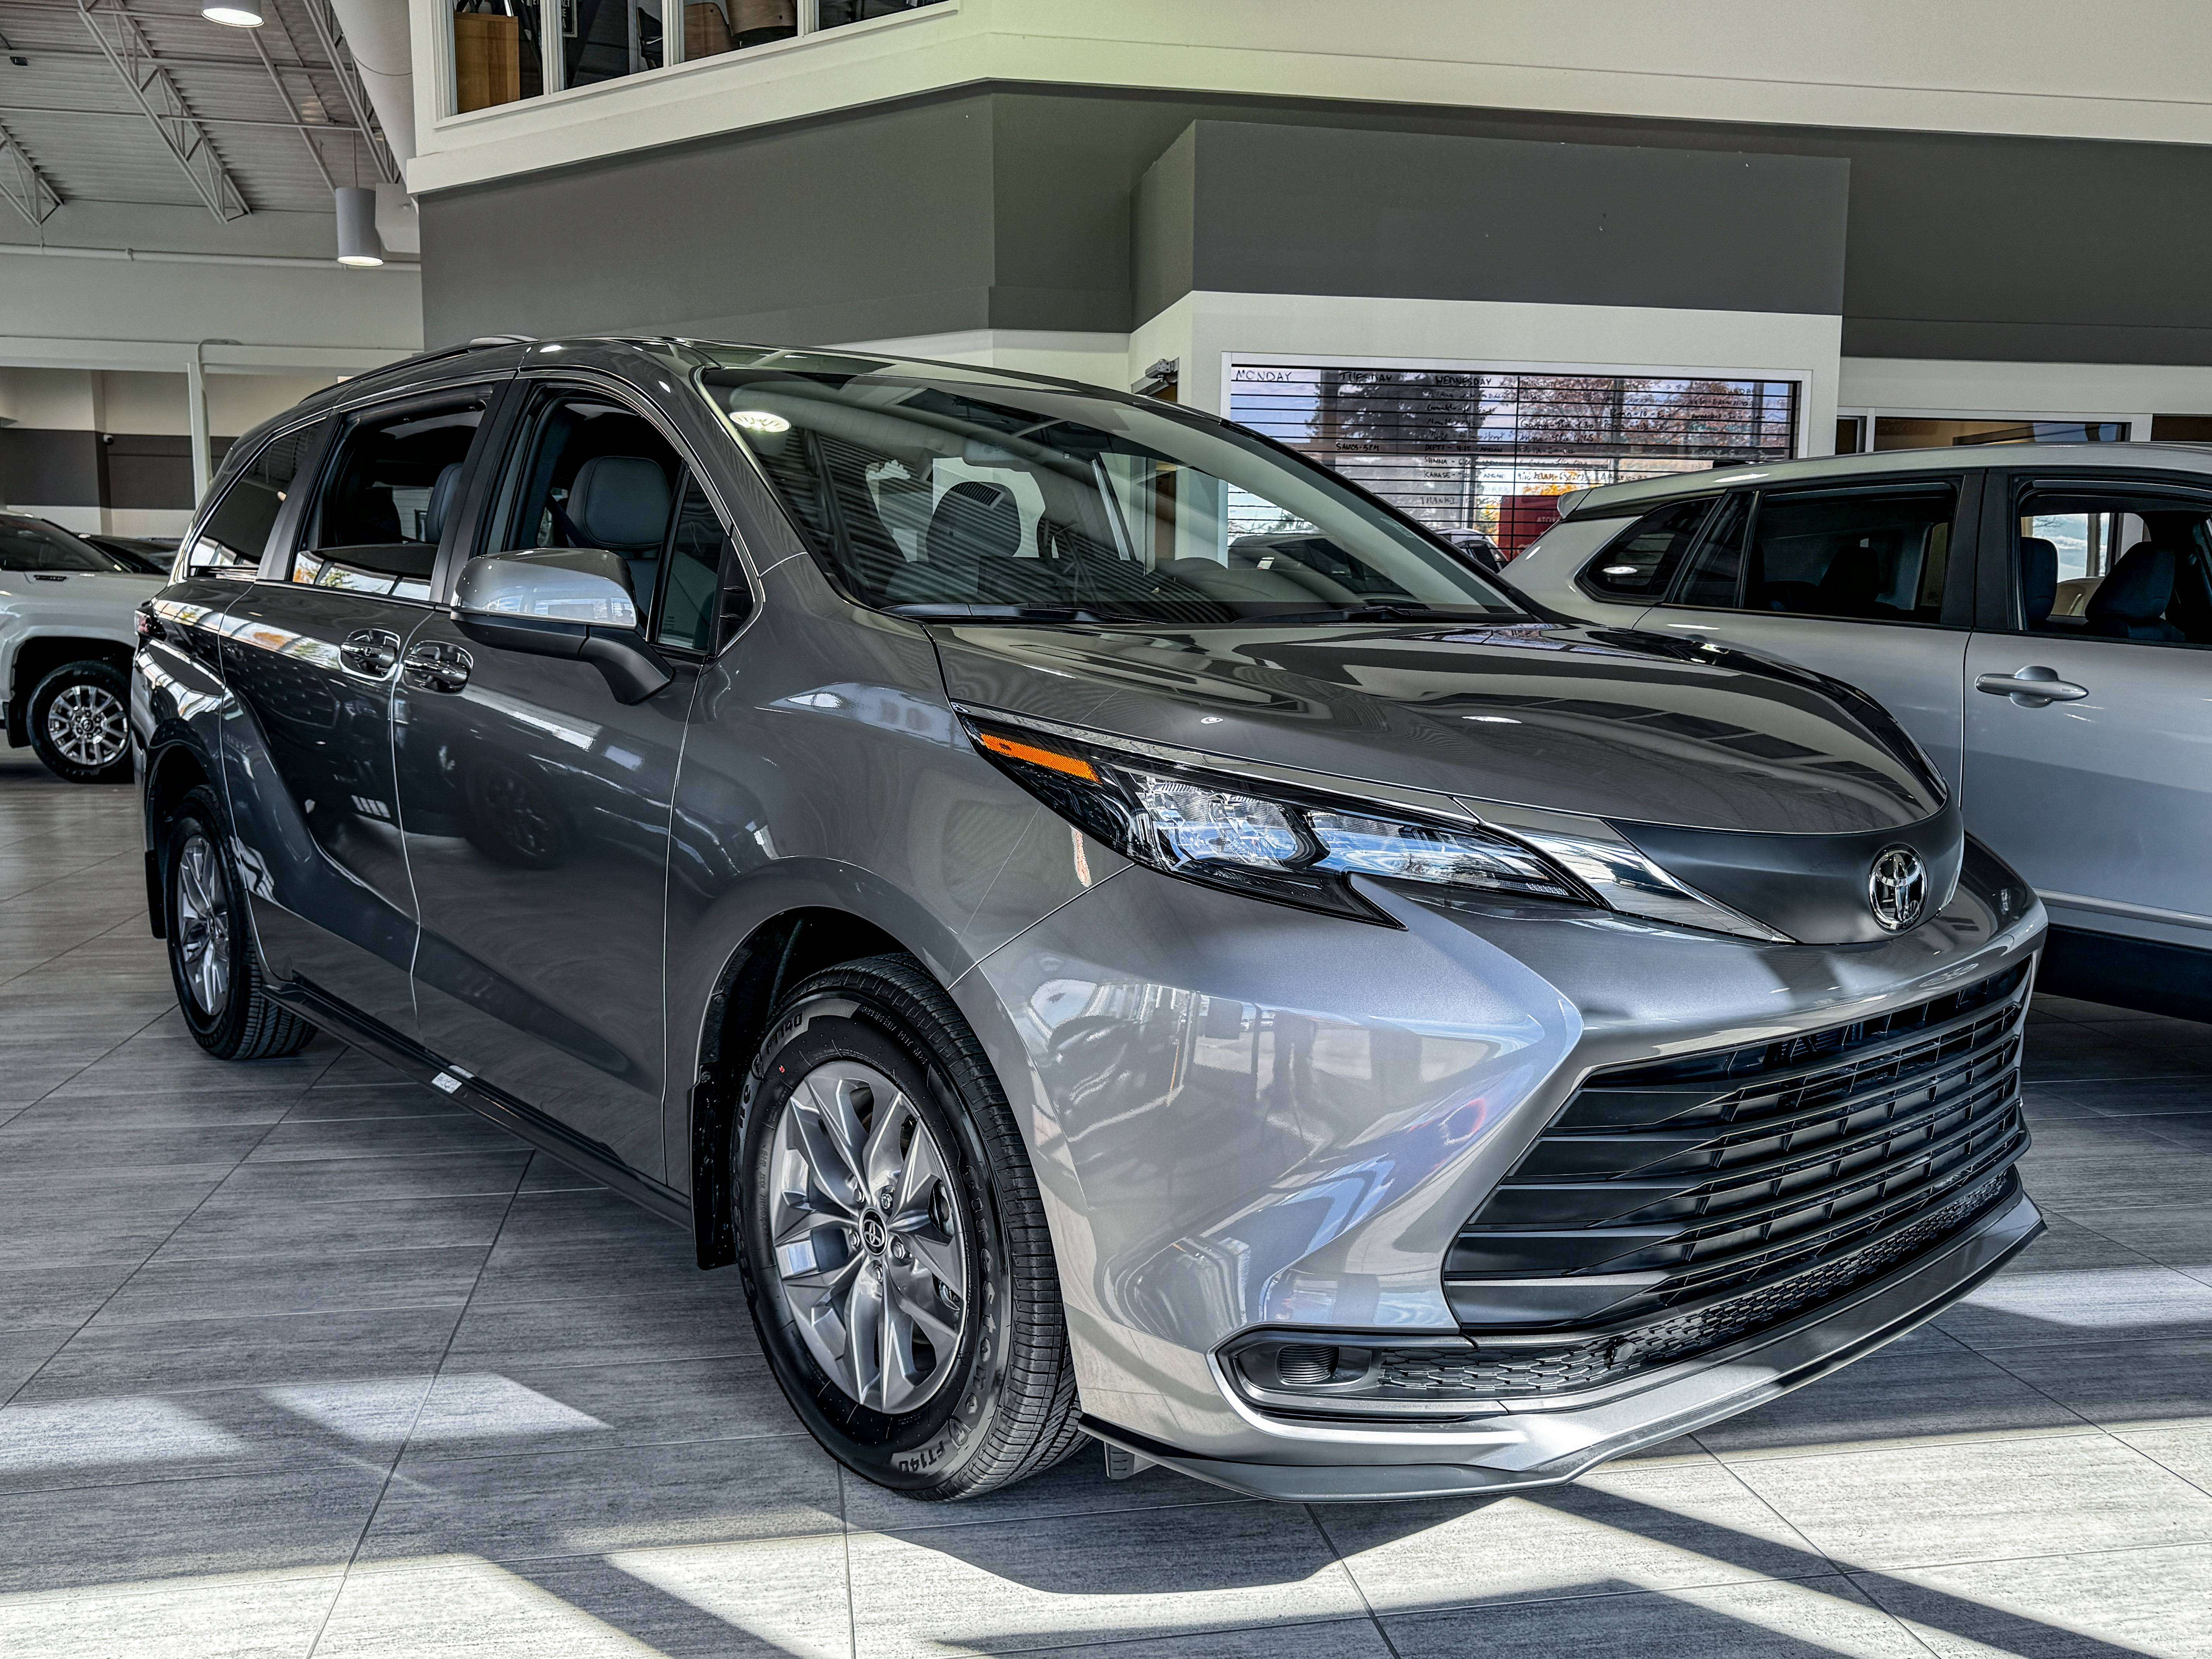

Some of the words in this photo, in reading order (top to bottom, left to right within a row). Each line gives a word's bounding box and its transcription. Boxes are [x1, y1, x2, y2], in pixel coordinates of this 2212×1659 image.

[1236, 370, 1291, 381] MONDAY
[1339, 371, 1392, 383] TUESDAY
[1435, 376, 1491, 385] WEDNESDAY
[766, 1012, 804, 1054] FT140
[962, 1165, 996, 1414] Firestone
[898, 1440, 946, 1472] FT140
